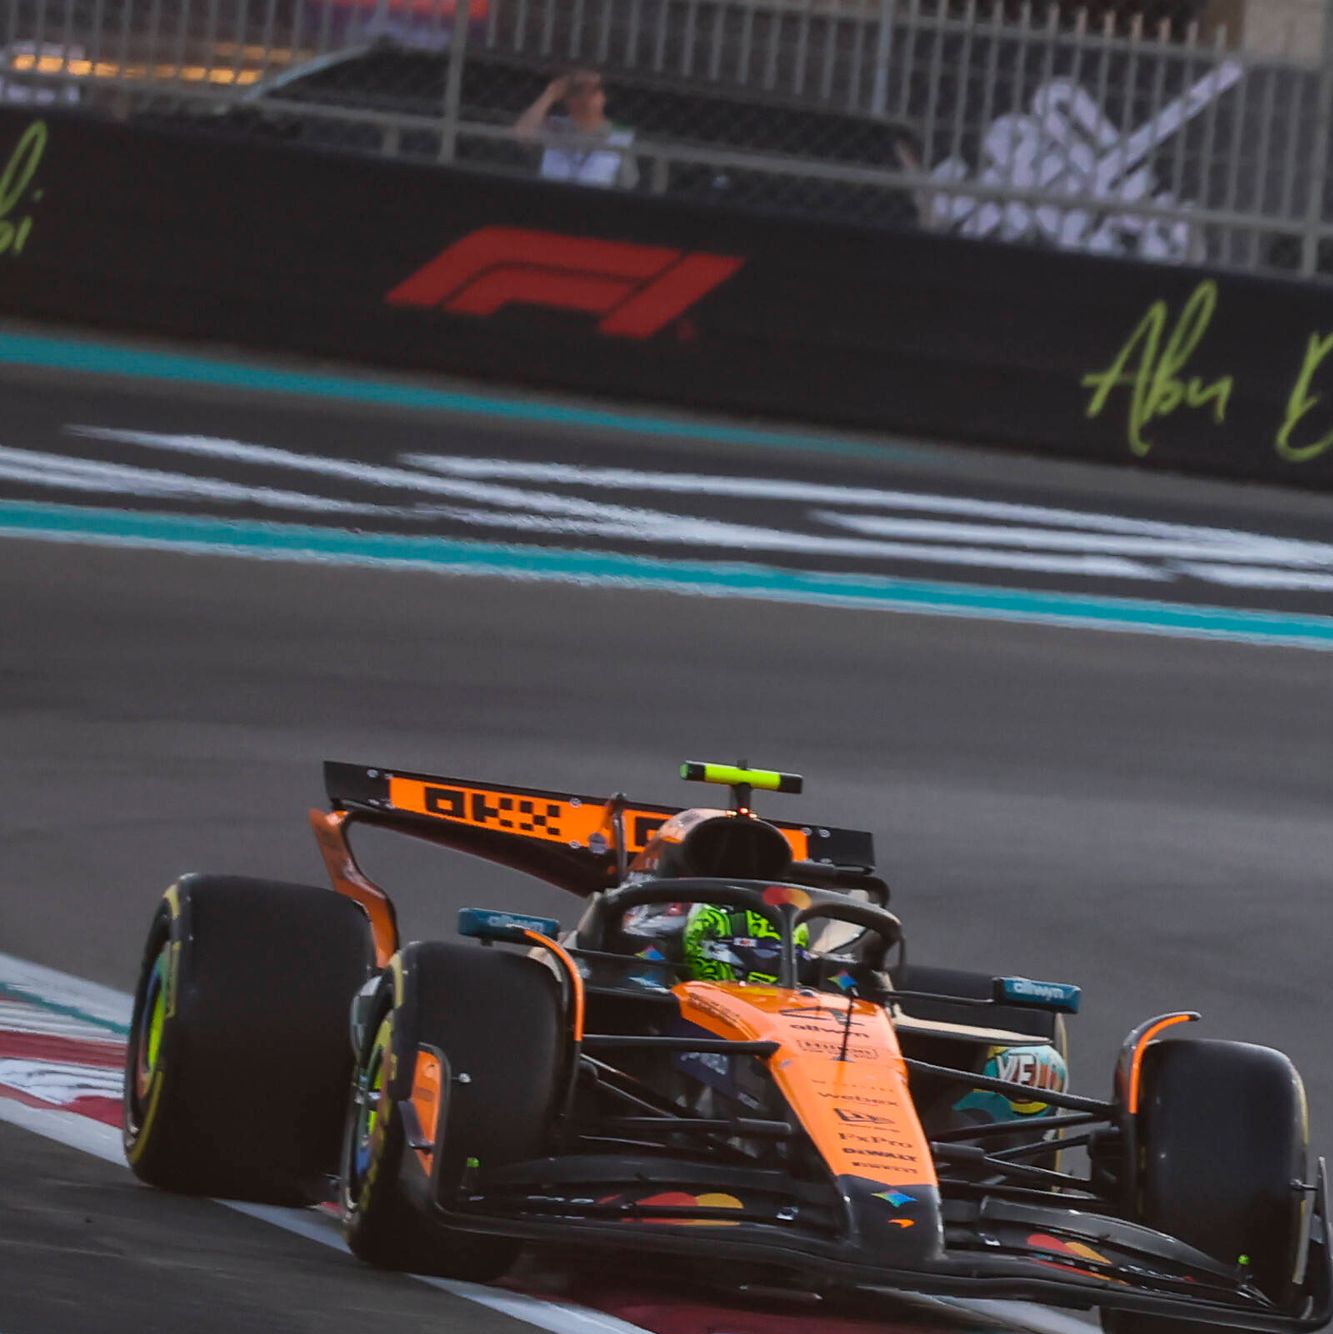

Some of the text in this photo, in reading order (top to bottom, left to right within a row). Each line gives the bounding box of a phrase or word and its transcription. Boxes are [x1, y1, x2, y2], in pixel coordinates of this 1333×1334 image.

[385, 225, 745, 340] F1
[1082, 278, 1233, 456] Abu
[424, 786, 560, 836] OKX
